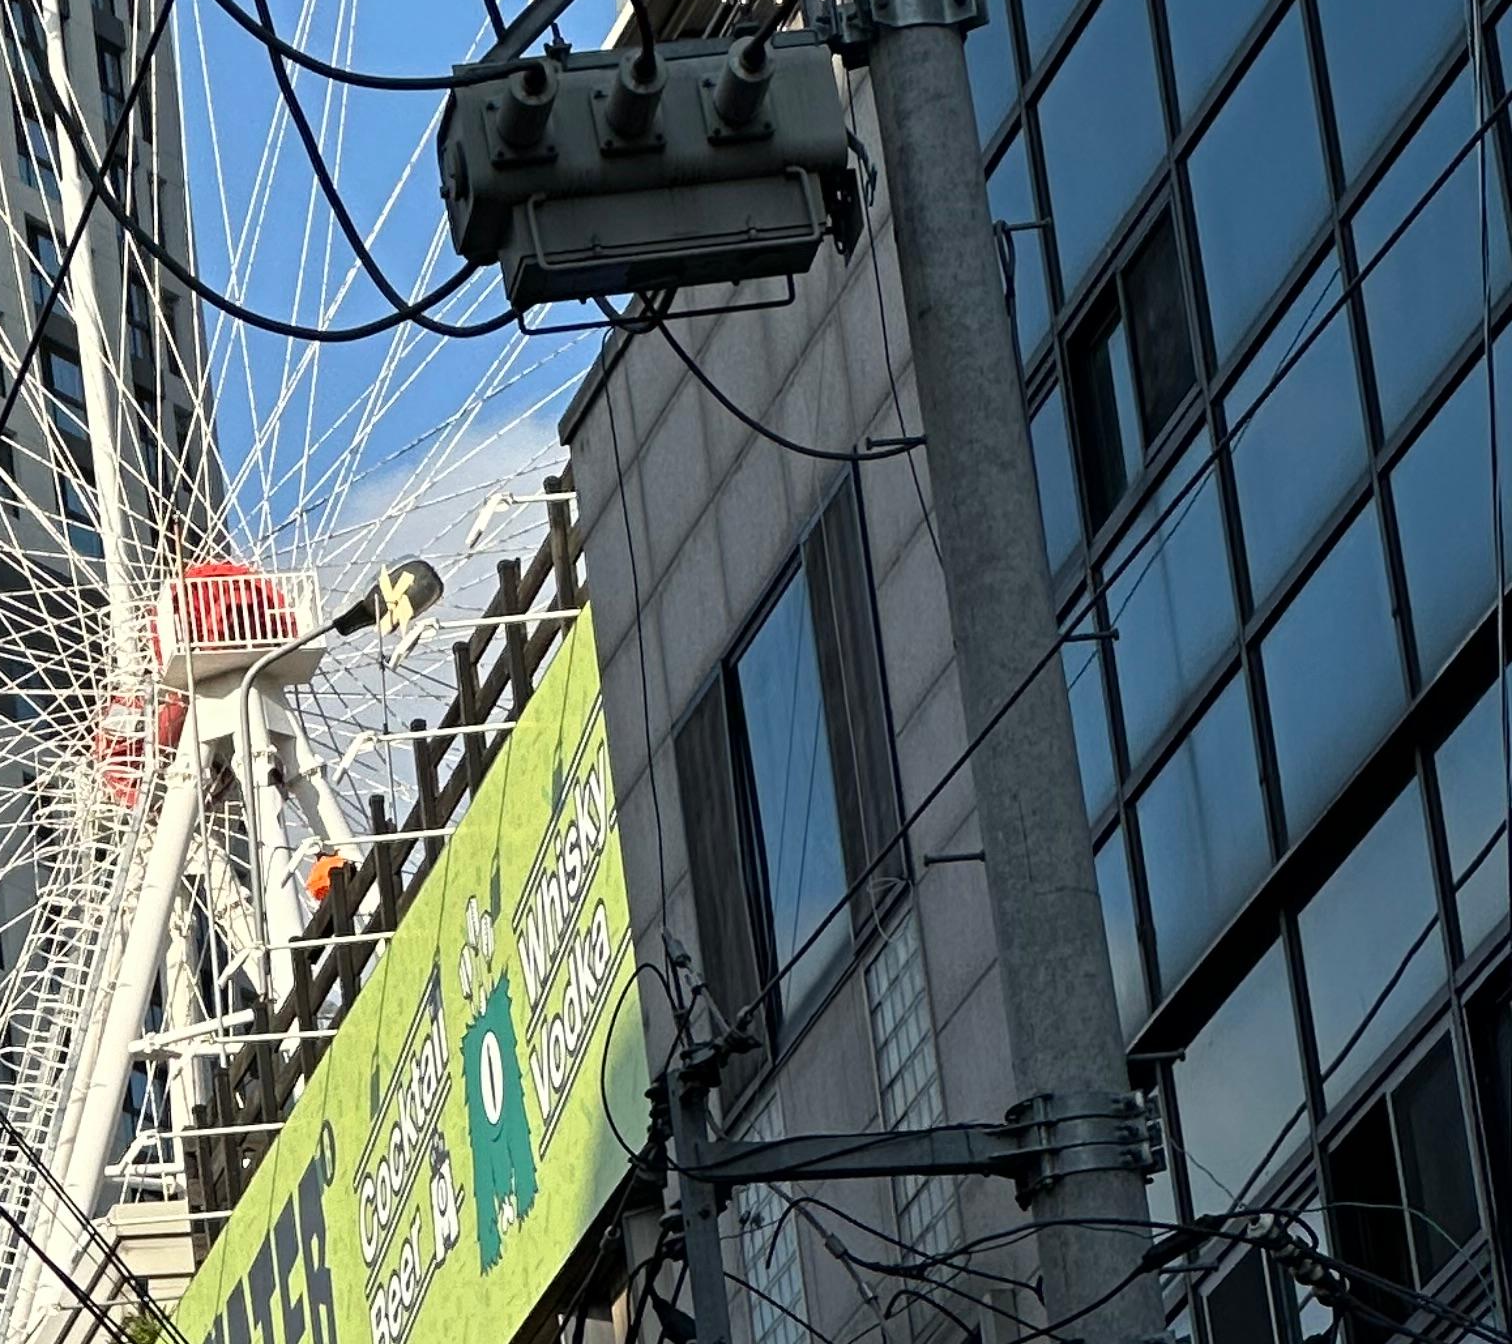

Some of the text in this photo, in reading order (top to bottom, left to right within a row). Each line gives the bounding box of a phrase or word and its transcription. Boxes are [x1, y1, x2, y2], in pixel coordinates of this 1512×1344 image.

[516, 739, 608, 1010] Whisky
[359, 1006, 449, 1266] Cocktail
[529, 898, 612, 1129] Vodka
